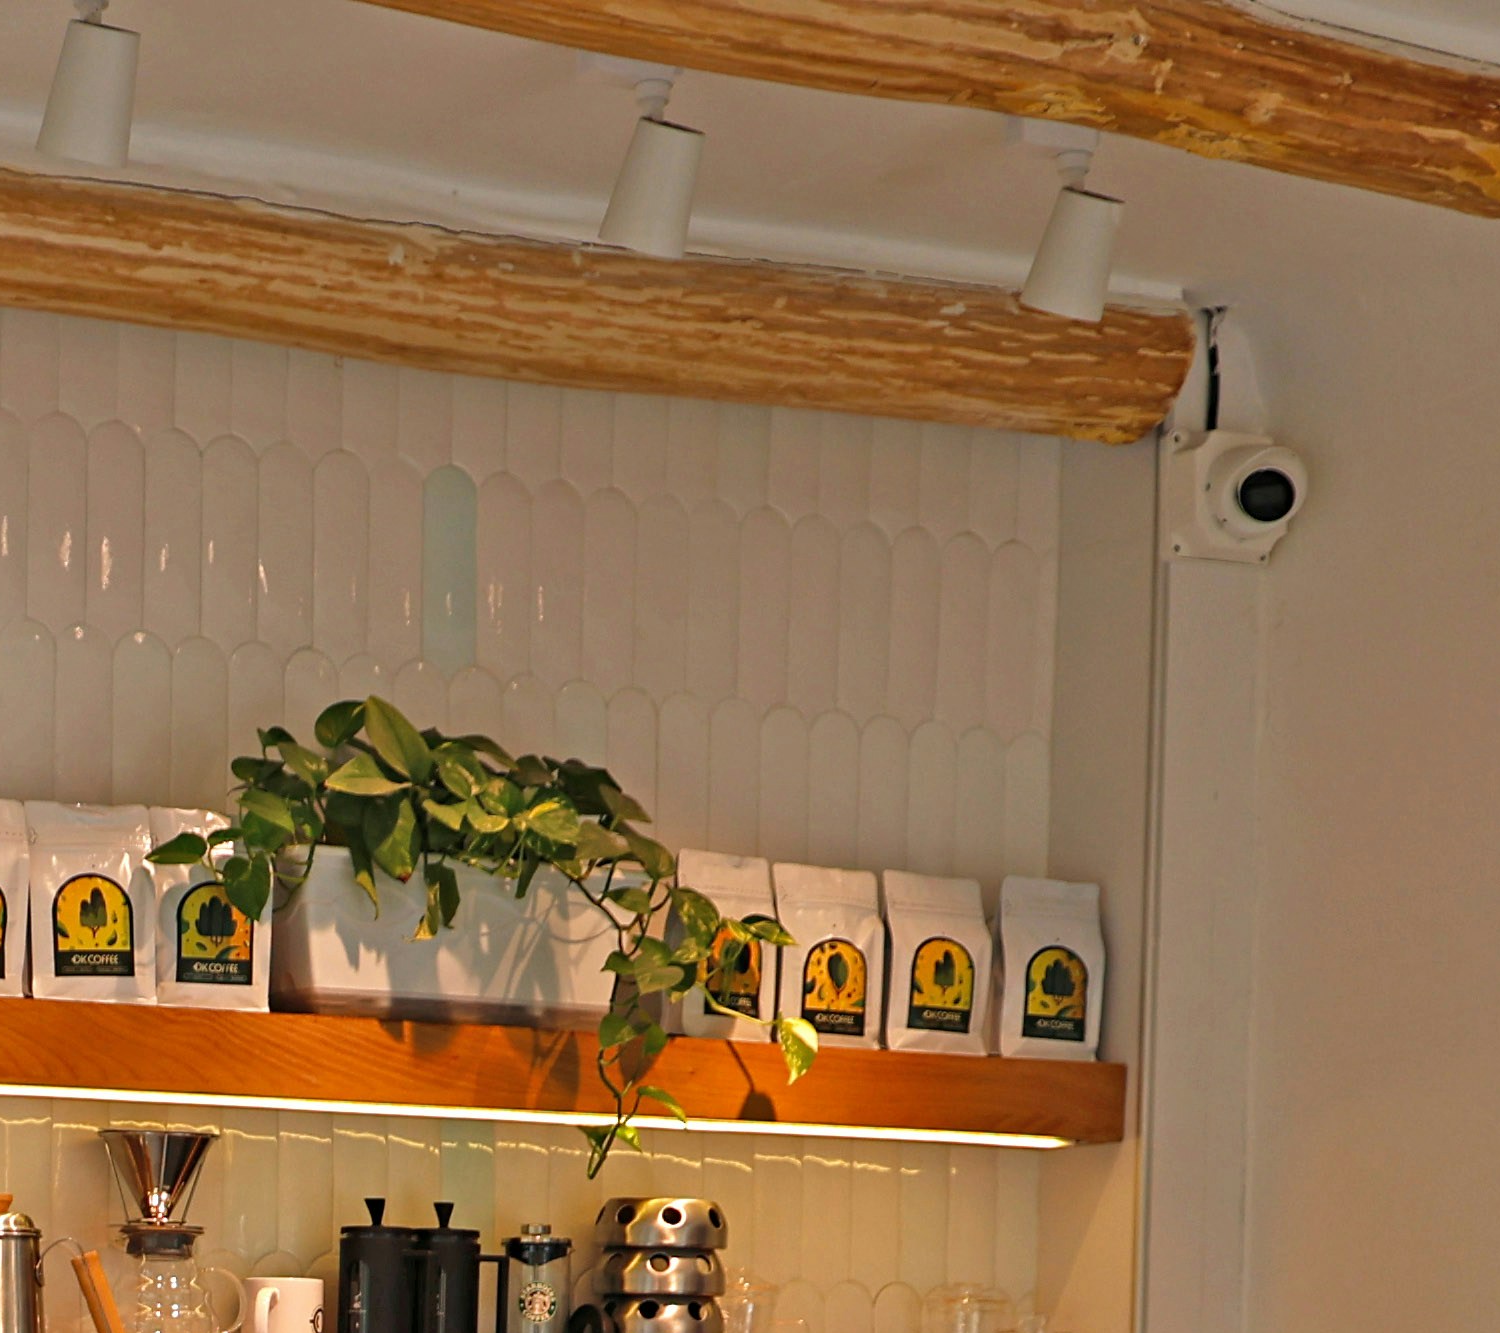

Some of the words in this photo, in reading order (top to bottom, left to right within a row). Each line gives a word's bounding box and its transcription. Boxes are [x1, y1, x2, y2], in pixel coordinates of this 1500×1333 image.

[71, 954, 87, 964] OK
[88, 954, 118, 965] COFFEE
[193, 961, 208, 972] OK
[209, 963, 238, 974] COFFEE
